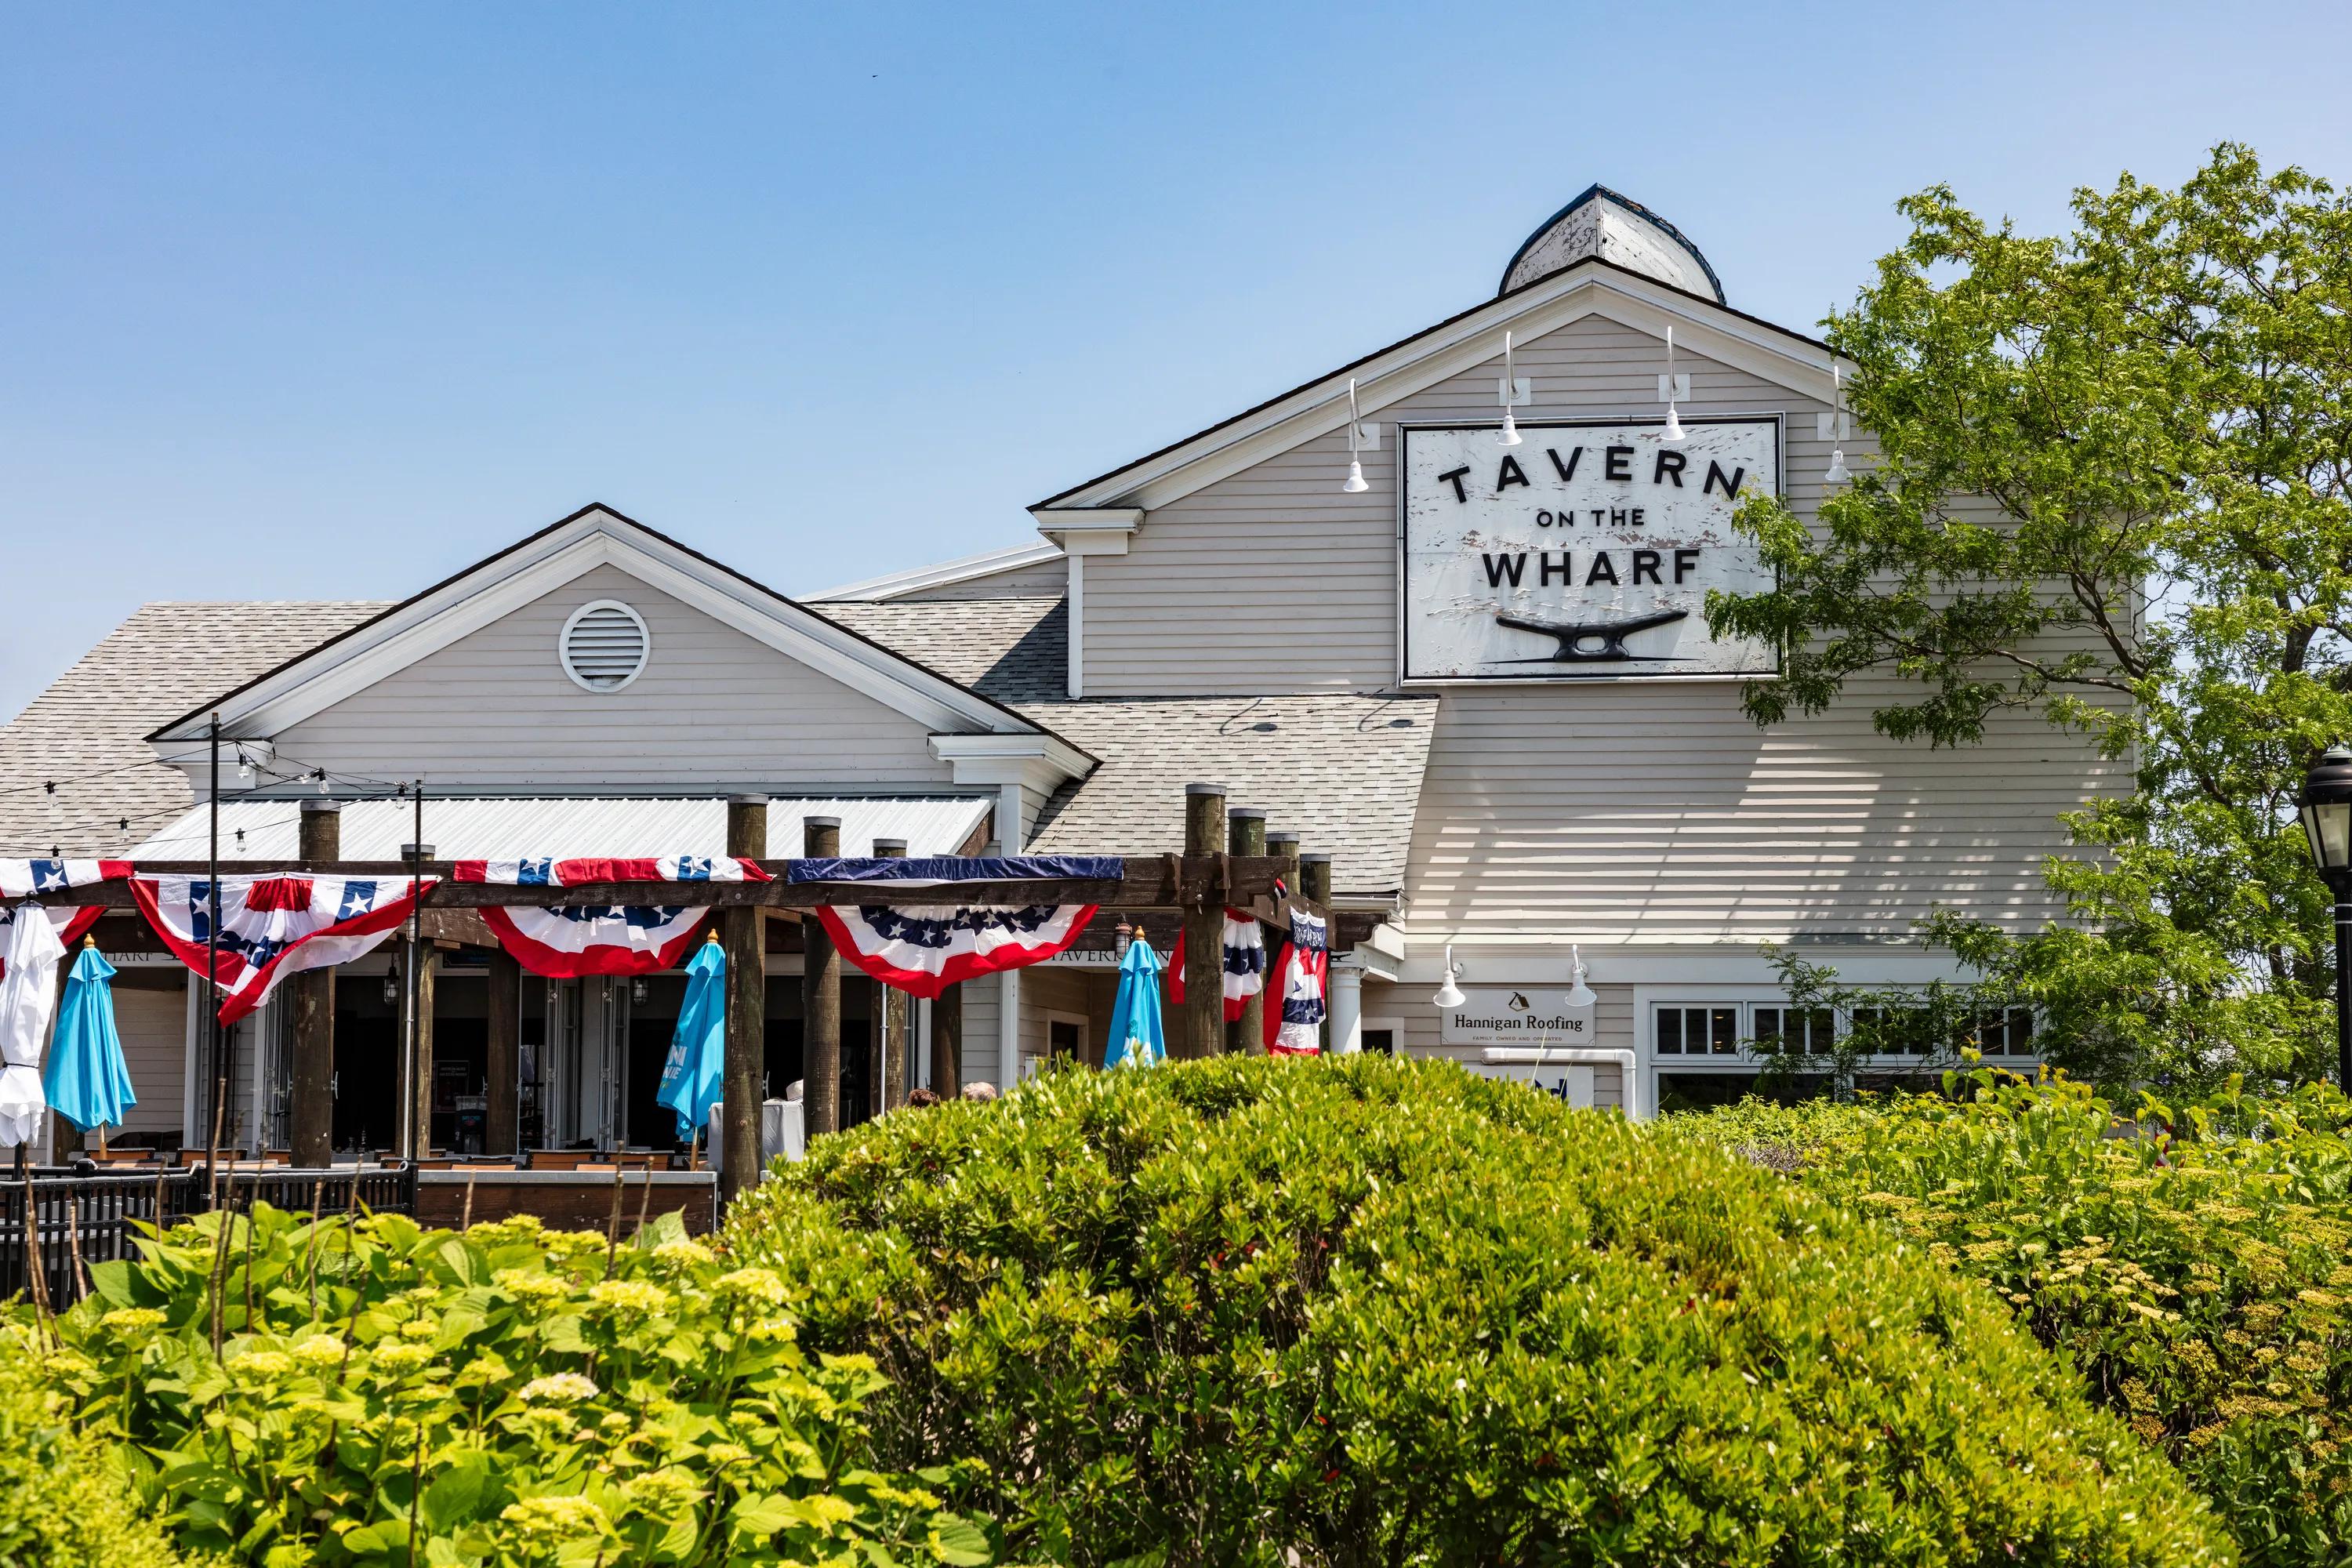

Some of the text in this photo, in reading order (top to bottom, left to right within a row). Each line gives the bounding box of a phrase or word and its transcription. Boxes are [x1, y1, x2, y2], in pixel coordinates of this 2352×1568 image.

[1437, 445, 1745, 503] TAVERN
[1536, 509, 1645, 528] ON THE
[1483, 548, 1700, 588] WHARF
[103, 952, 153, 962] HARF
[1454, 1014, 1584, 1033] Hannigan Roofing
